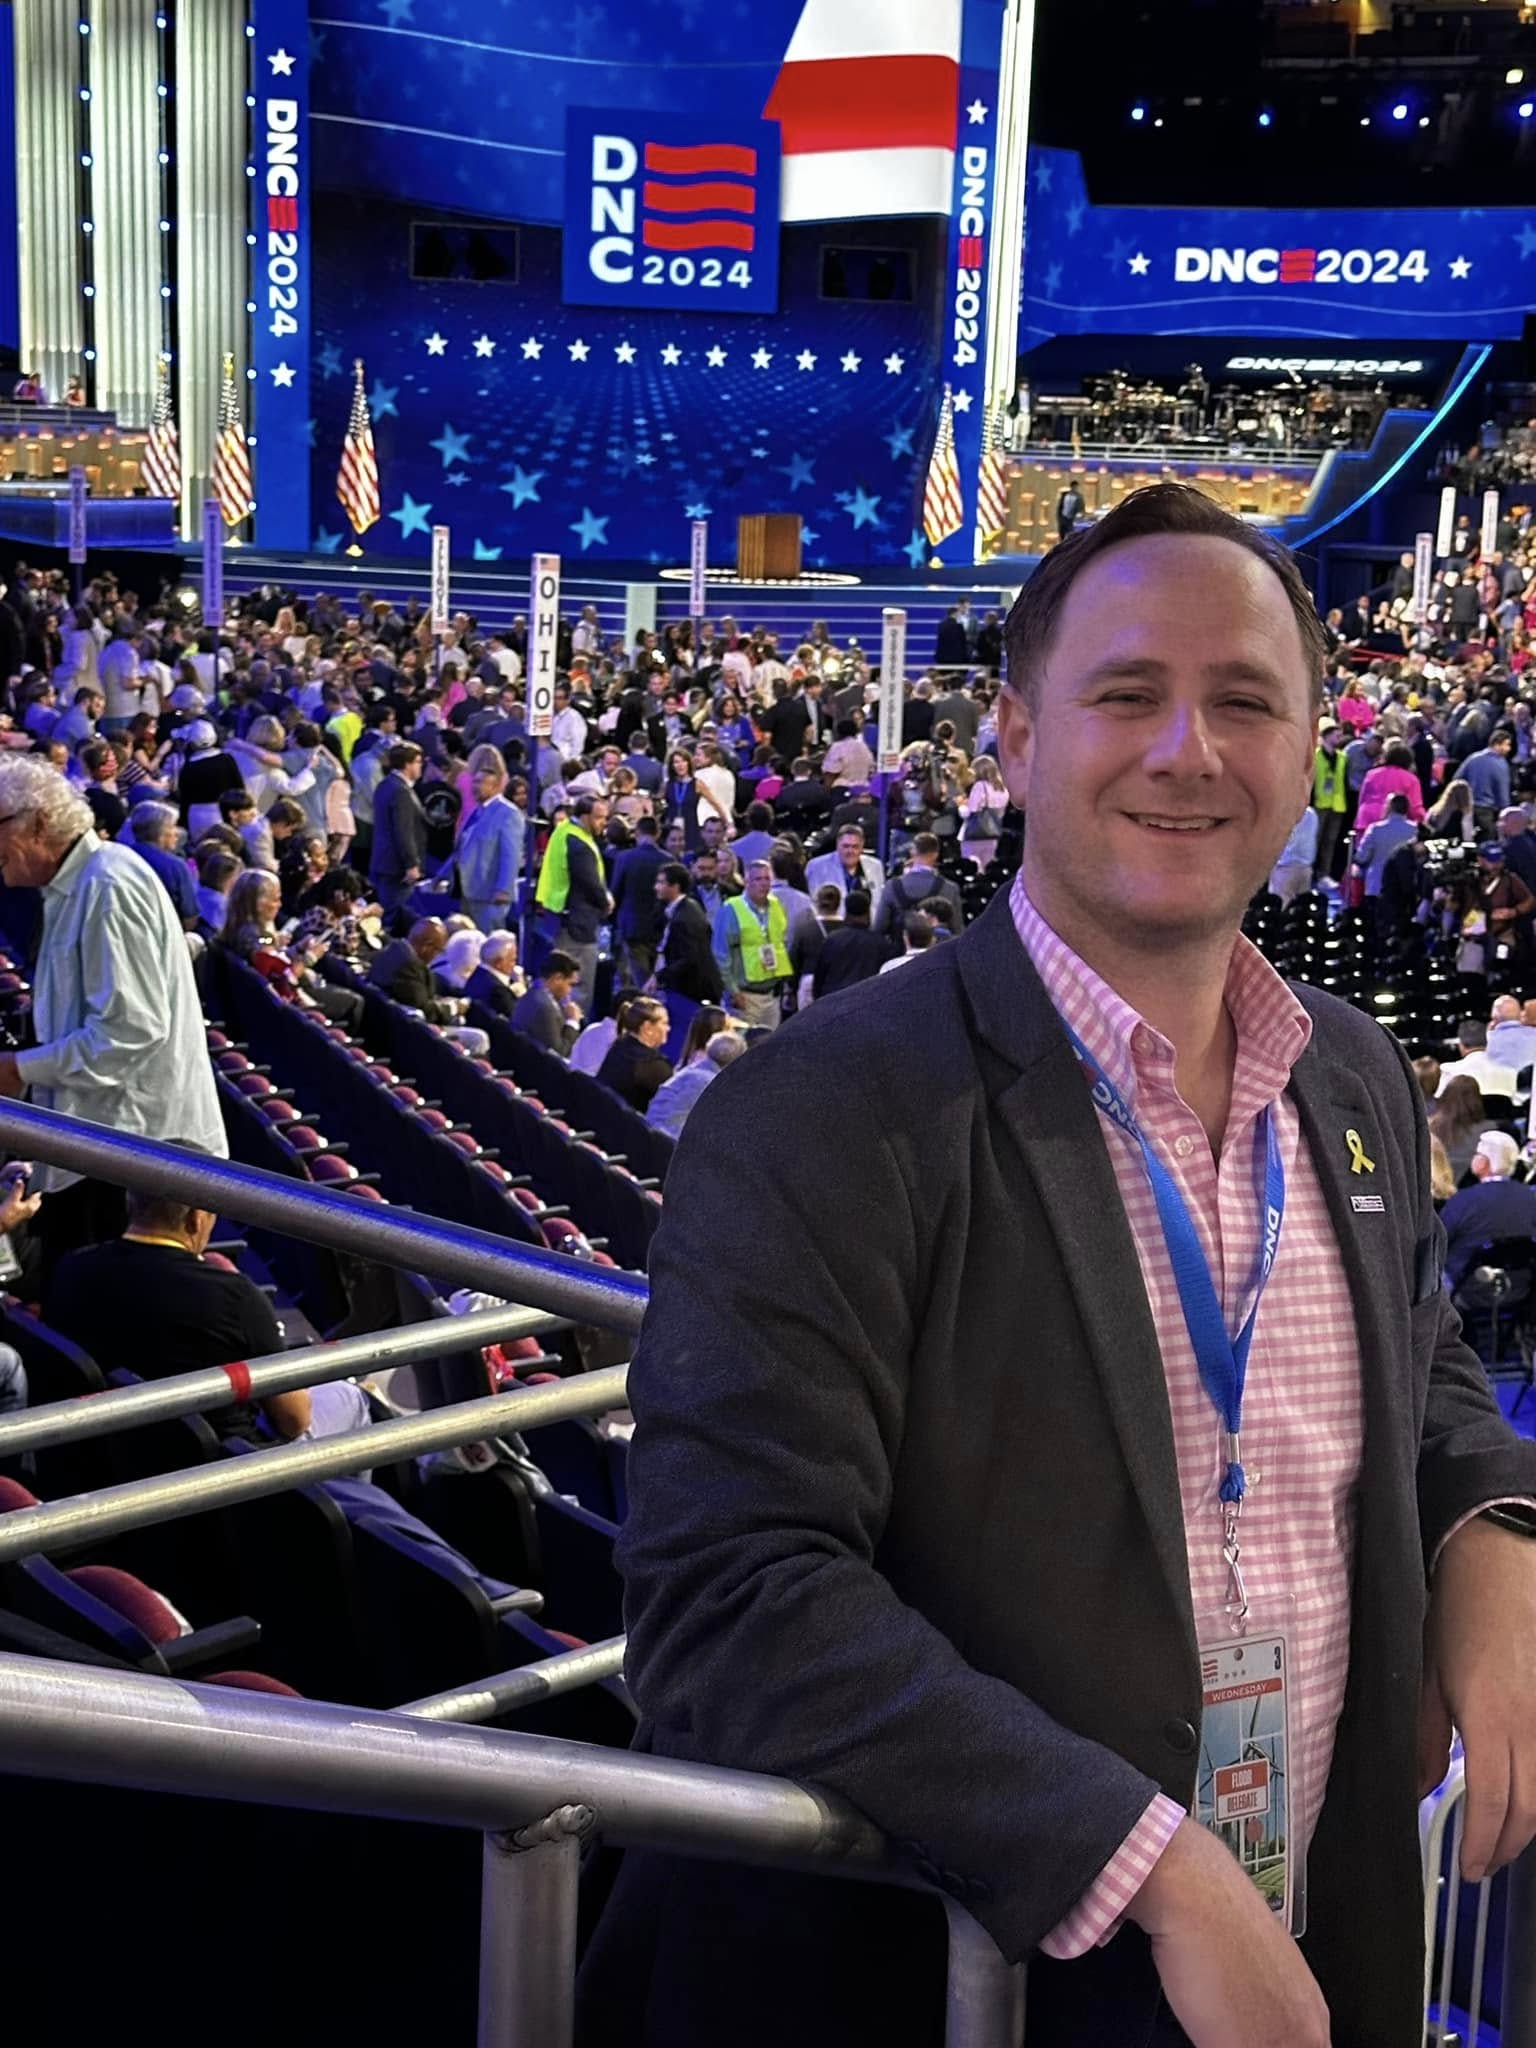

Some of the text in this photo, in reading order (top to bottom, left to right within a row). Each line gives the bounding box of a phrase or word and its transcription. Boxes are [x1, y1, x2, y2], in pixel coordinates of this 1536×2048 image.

[266, 98, 298, 338] DNC 2024
[589, 135, 638, 283] DNC
[642, 256, 752, 289] 2024
[953, 147, 988, 367] DNC 2024
[1174, 247, 1430, 284] DNC 2024
[534, 576, 557, 711] OHIO
[1263, 1205, 1280, 1275] DNC
[1274, 1646, 1281, 1670] 3
[1212, 1682, 1267, 1702] WEDNESDAY
[1231, 1769, 1253, 1789] FLOOR
[1227, 1792, 1258, 1813] DELEGATE
